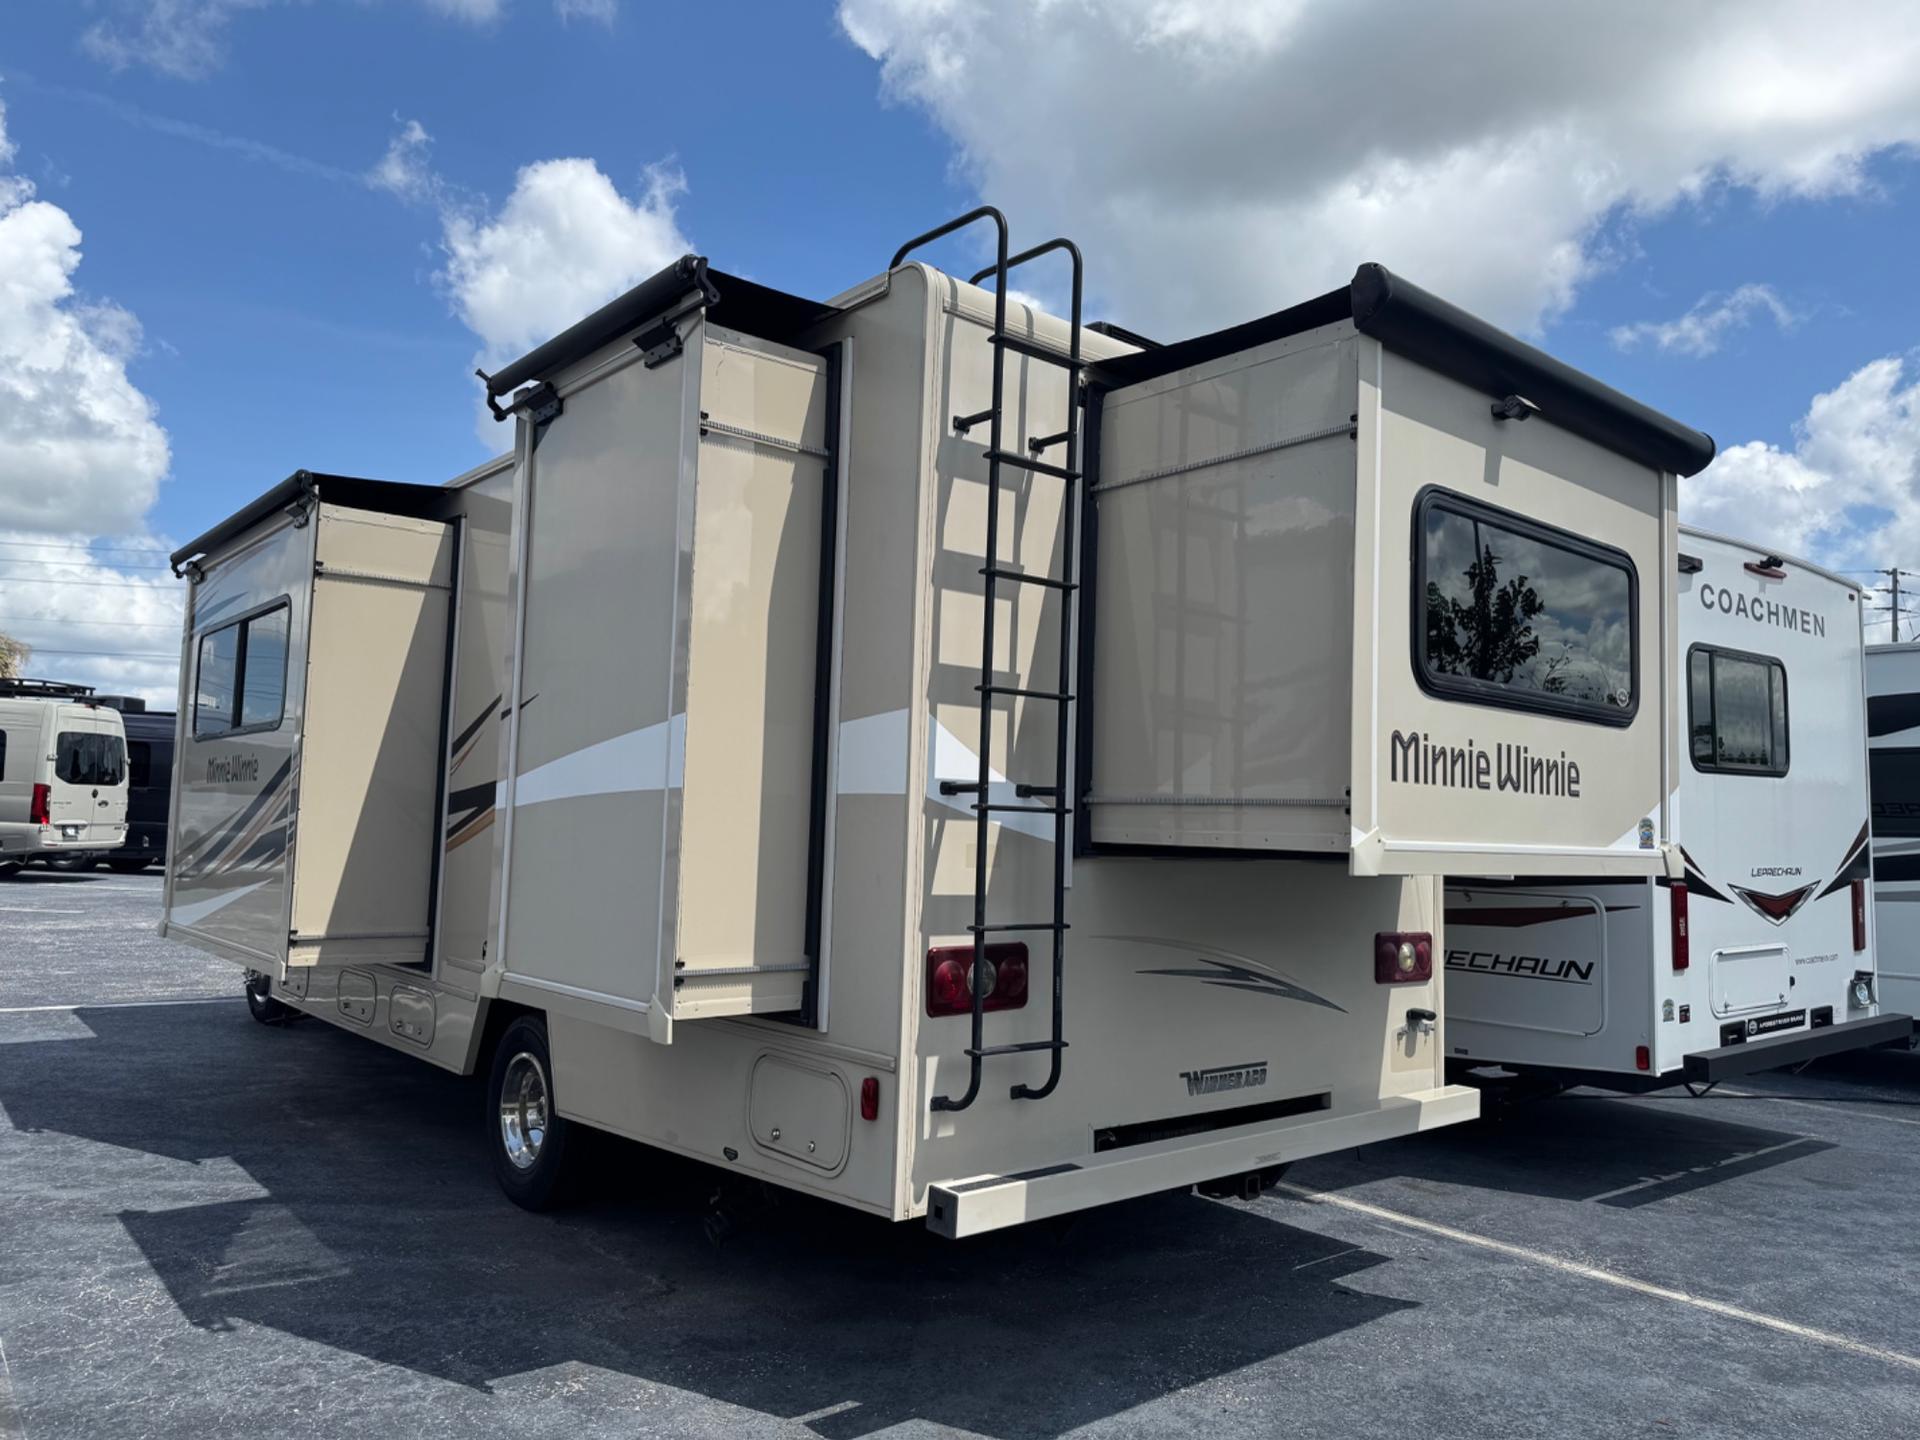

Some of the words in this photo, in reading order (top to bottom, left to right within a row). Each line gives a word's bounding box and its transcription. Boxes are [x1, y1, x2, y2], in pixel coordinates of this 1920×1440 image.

[1700, 583, 1826, 638] COACHMEN
[1751, 866, 1802, 878] LEPRECHAUN
[1444, 949, 1594, 980] ECHAUN
